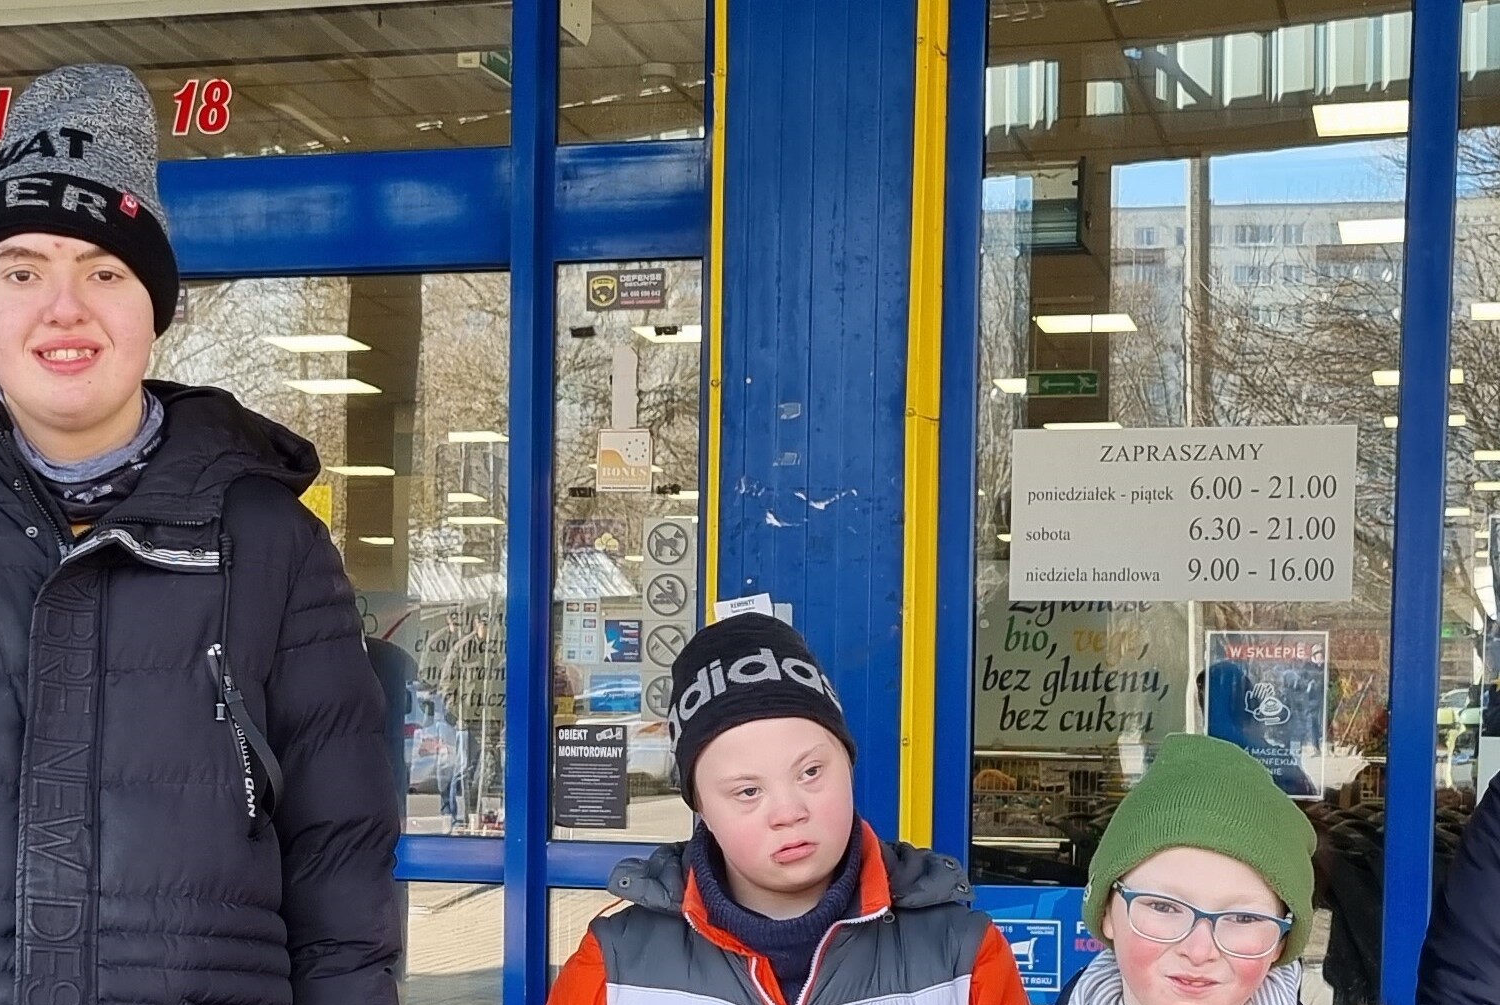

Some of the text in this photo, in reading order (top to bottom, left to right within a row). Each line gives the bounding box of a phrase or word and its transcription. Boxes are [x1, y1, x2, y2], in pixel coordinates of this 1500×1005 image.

[172, 79, 233, 136] 18
[620, 274, 662, 282] DEFENSE
[1099, 443, 1264, 463] ZAPRASZAMY
[602, 467, 648, 477] BONUS
[1028, 486, 1116, 505] poniedziałek
[1131, 486, 1174, 505] piątek
[1190, 475, 1242, 500] 6.00
[1267, 474, 1338, 499] 21.00
[1026, 527, 1071, 541] sobota
[1188, 516, 1241, 541] 6.30
[1266, 516, 1336, 540] 21.00
[1026, 568, 1088, 582] niedziela
[1092, 567, 1160, 582] handlowa
[1188, 557, 1240, 582] 9.00
[1268, 557, 1335, 582] 16.00
[1004, 615, 1057, 660] bio,
[1230, 647, 1306, 658] W SKLEPIE
[982, 654, 1169, 706] bez glutenu,
[1000, 694, 1154, 732] bez cukru
[558, 728, 589, 740] OBIEKT
[558, 745, 624, 758] MONITOROWANY
